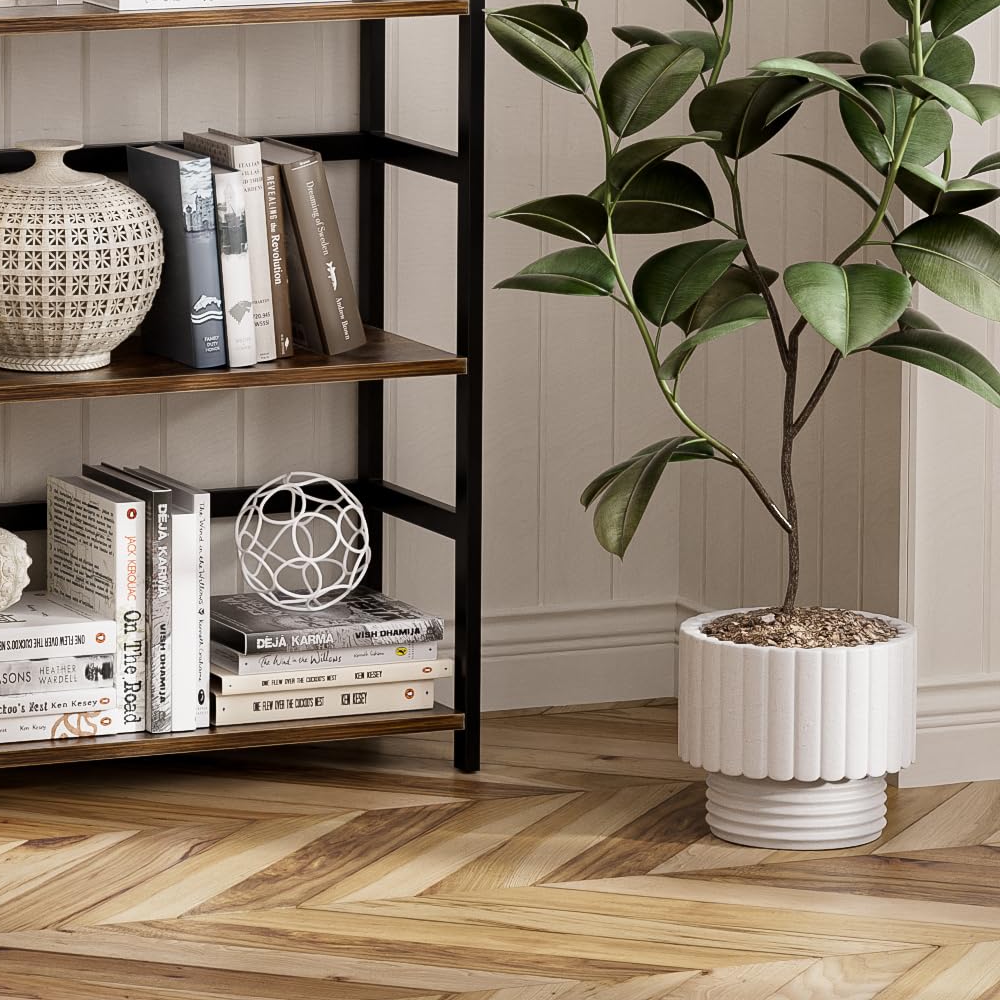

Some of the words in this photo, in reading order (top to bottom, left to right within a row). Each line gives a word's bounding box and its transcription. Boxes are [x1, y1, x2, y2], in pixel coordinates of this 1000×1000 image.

[266, 175, 278, 220] REVEALING
[305, 180, 320, 219] Dreaming
[270, 222, 278, 233] the
[316, 217, 324, 227] of
[317, 225, 329, 256] Sweden
[271, 234, 283, 285] Revolution
[124, 535, 137, 557] JACK
[157, 545, 168, 599] KARMA
[126, 558, 137, 601] KEROUAC
[123, 610, 142, 633] On
[60, 635, 74, 646] FLEW
[75, 634, 86, 645] ONE
[292, 633, 334, 646] KARMA
[355, 630, 378, 639] VISH
[379, 628, 421, 637] DHAMIJA
[33, 638, 44, 648] THE
[44, 636, 59, 647] OVER
[124, 639, 143, 675] The
[260, 655, 271, 668] The
[272, 655, 291, 666] Wind
[310, 650, 342, 665] Willows
[39, 664, 76, 675] HEATHER
[366, 670, 383, 679] KESEY
[38, 675, 78, 684] WARDELL
[51, 701, 68, 709] Ken
[71, 699, 98, 709] Kesey
[123, 681, 142, 725] Road
[252, 701, 261, 712] ONE
[262, 700, 273, 711] FLEW
[274, 699, 285, 710] OVER
[286, 699, 294, 709] THE
[314, 696, 325, 707] NEST
[341, 693, 350, 706] KEN
[352, 691, 367, 705] KESEY
[28, 701, 49, 713] Nest
